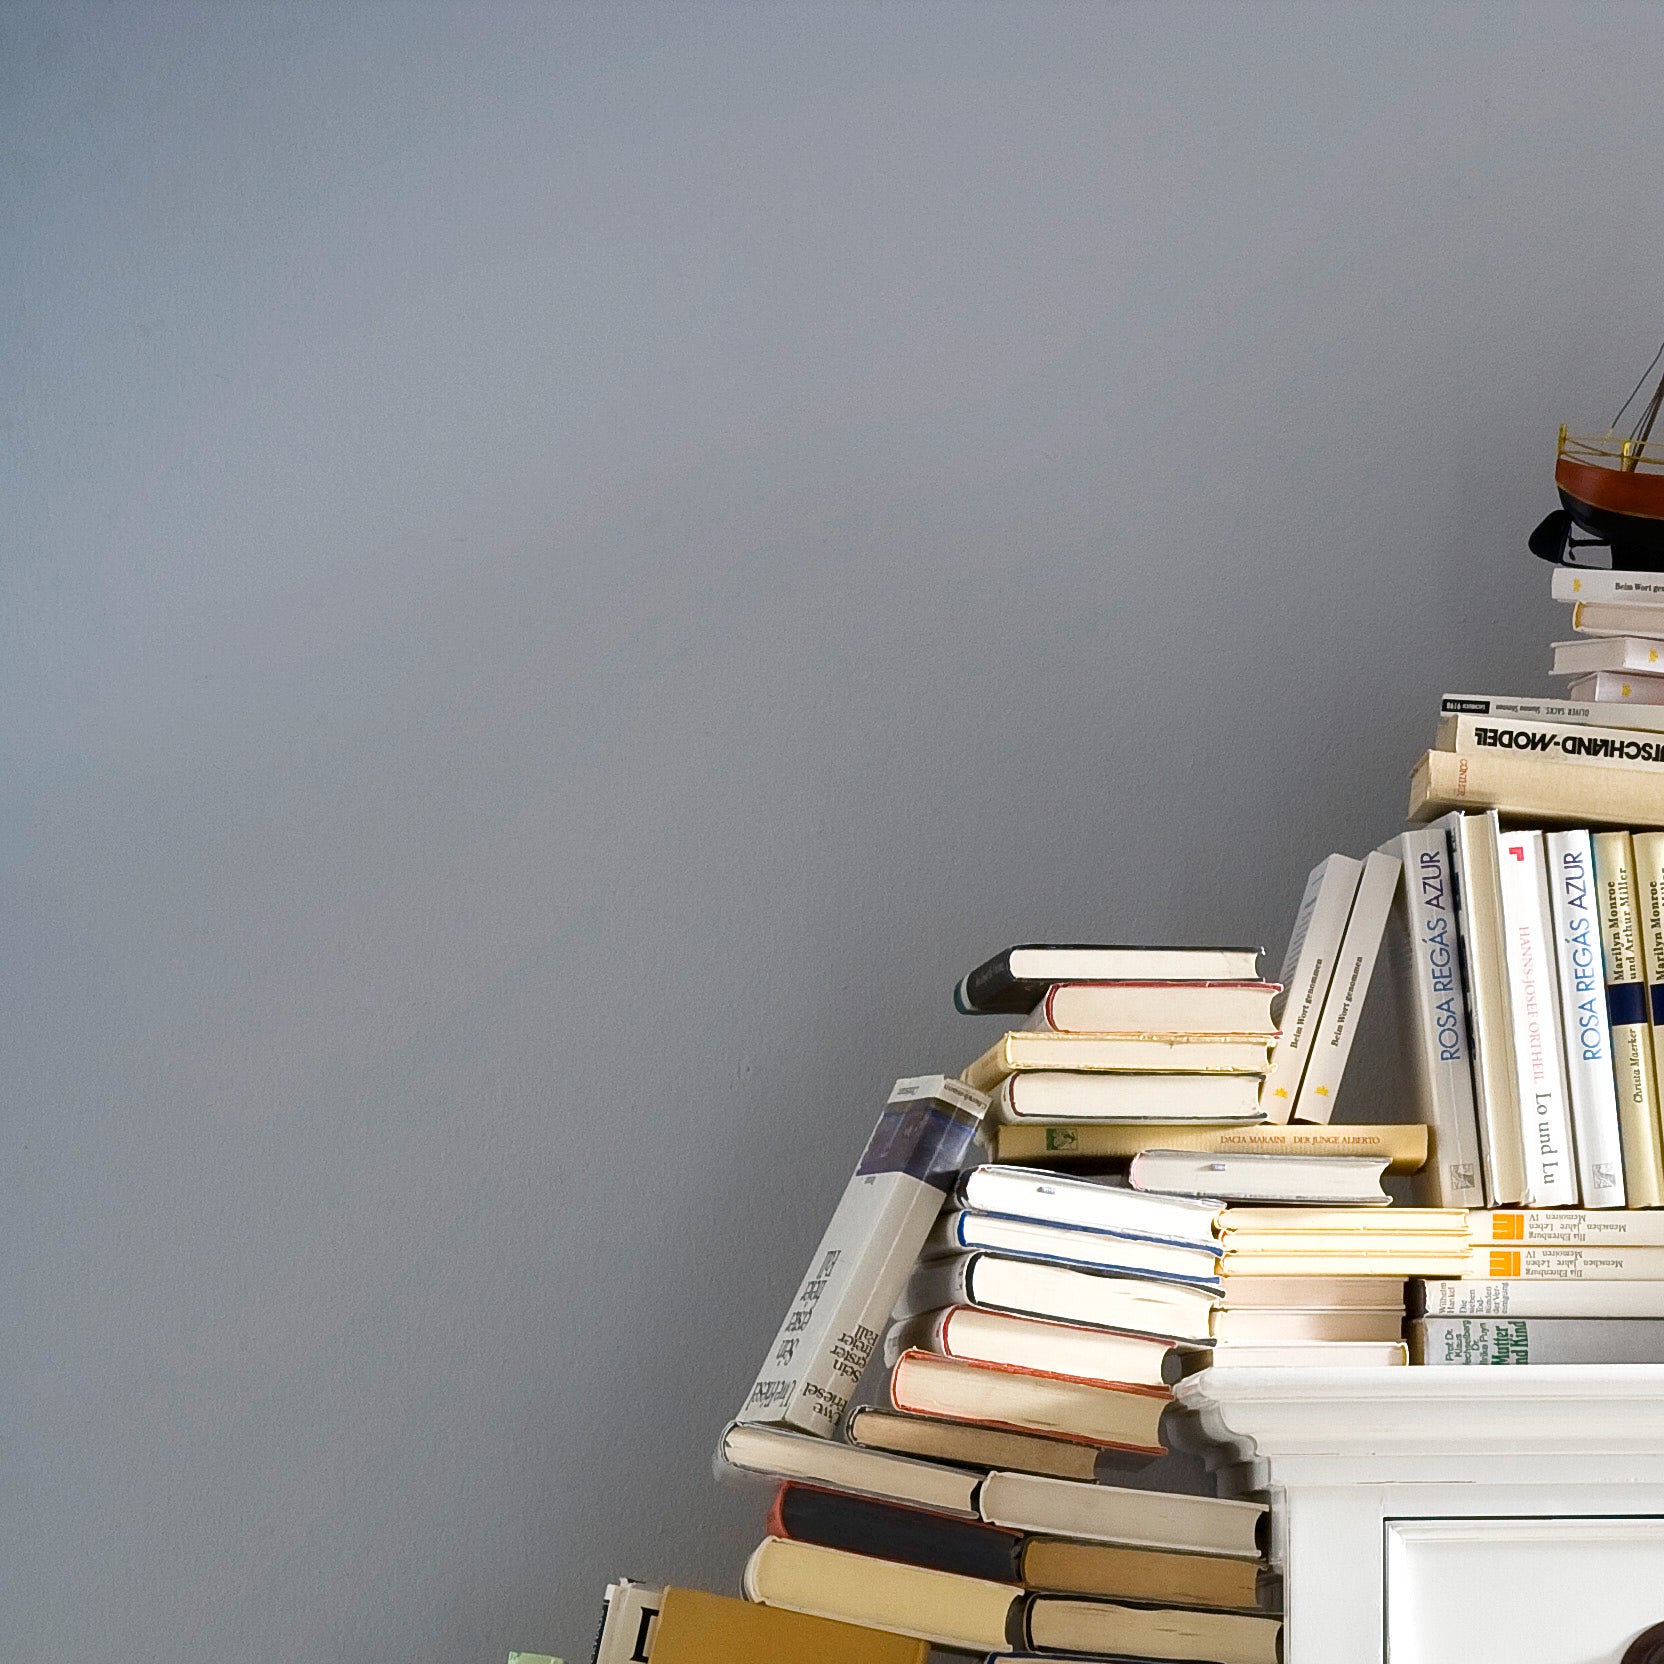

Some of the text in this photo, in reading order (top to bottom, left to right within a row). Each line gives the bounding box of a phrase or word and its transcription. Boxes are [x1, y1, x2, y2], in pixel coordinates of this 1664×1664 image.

[1615, 582, 1633, 591] Beim
[1635, 583, 1652, 592] Wort
[1420, 851, 1460, 1060] ROSA REGÁS AZUR
[1608, 880, 1624, 980] Marilyn Monroe
[1618, 868, 1637, 979] und Arthur Miller
